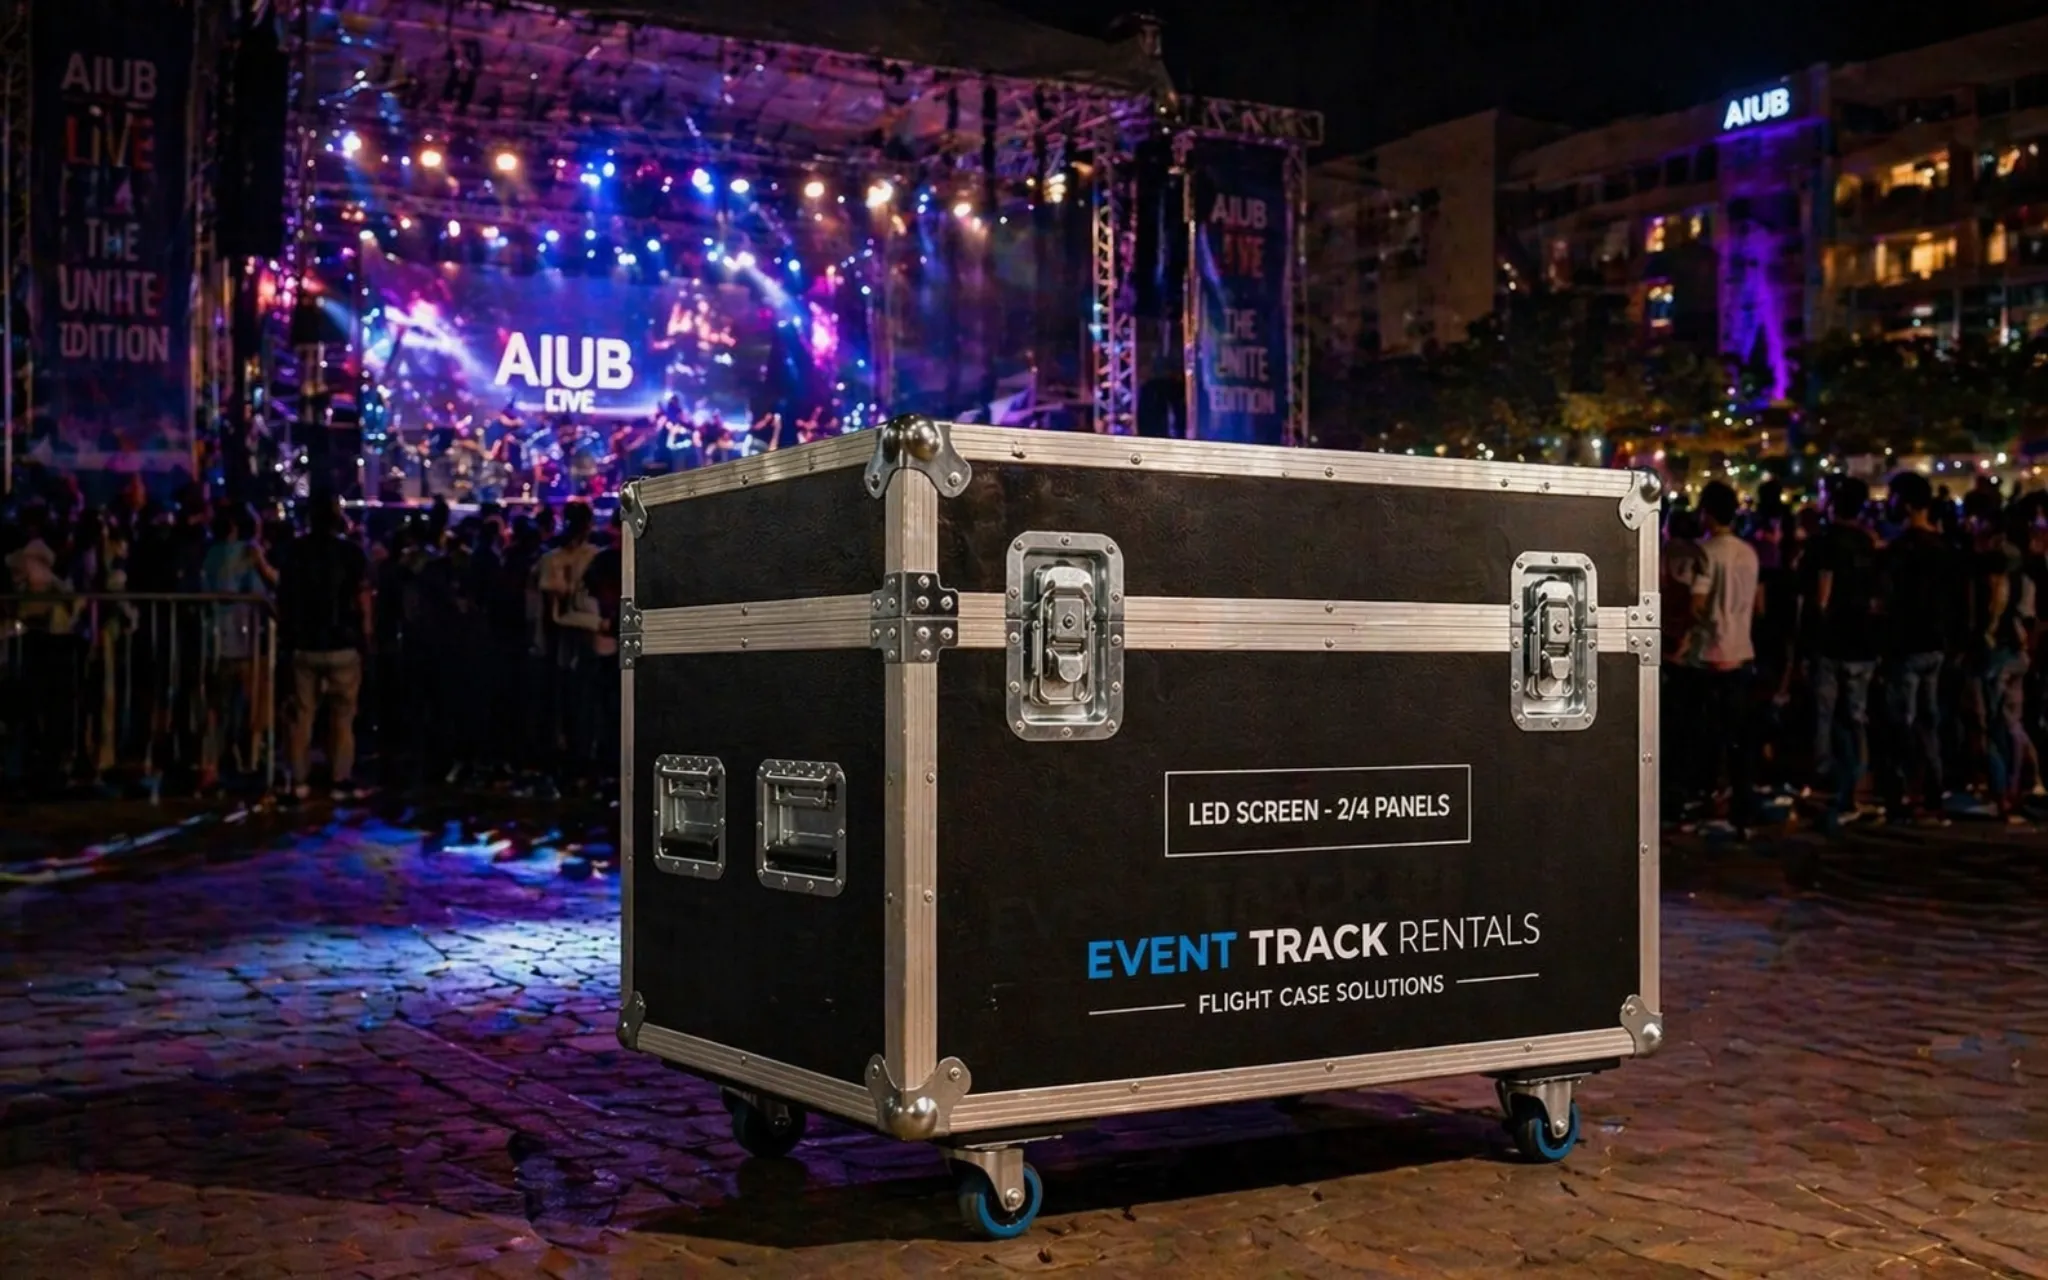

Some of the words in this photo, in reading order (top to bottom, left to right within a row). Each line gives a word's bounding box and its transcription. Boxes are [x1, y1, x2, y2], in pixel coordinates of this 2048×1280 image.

[61, 52, 157, 99] AIUB
[1723, 87, 1790, 130] AIUB
[85, 218, 140, 262] THE
[494, 332, 634, 389] AIUB
[1189, 802, 1230, 826] LED
[1236, 799, 1319, 824] SCREEN
[1337, 797, 1369, 821] 2/4
[1375, 794, 1450, 819] PANELS
[1087, 931, 1238, 979] EVENT
[1248, 921, 1389, 966] TRACK
[1399, 912, 1541, 954] RENTALS
[1199, 989, 1274, 1014] FLIGHT
[1279, 983, 1331, 1007] CASE
[1336, 974, 1445, 1003] SOLUTIONS
